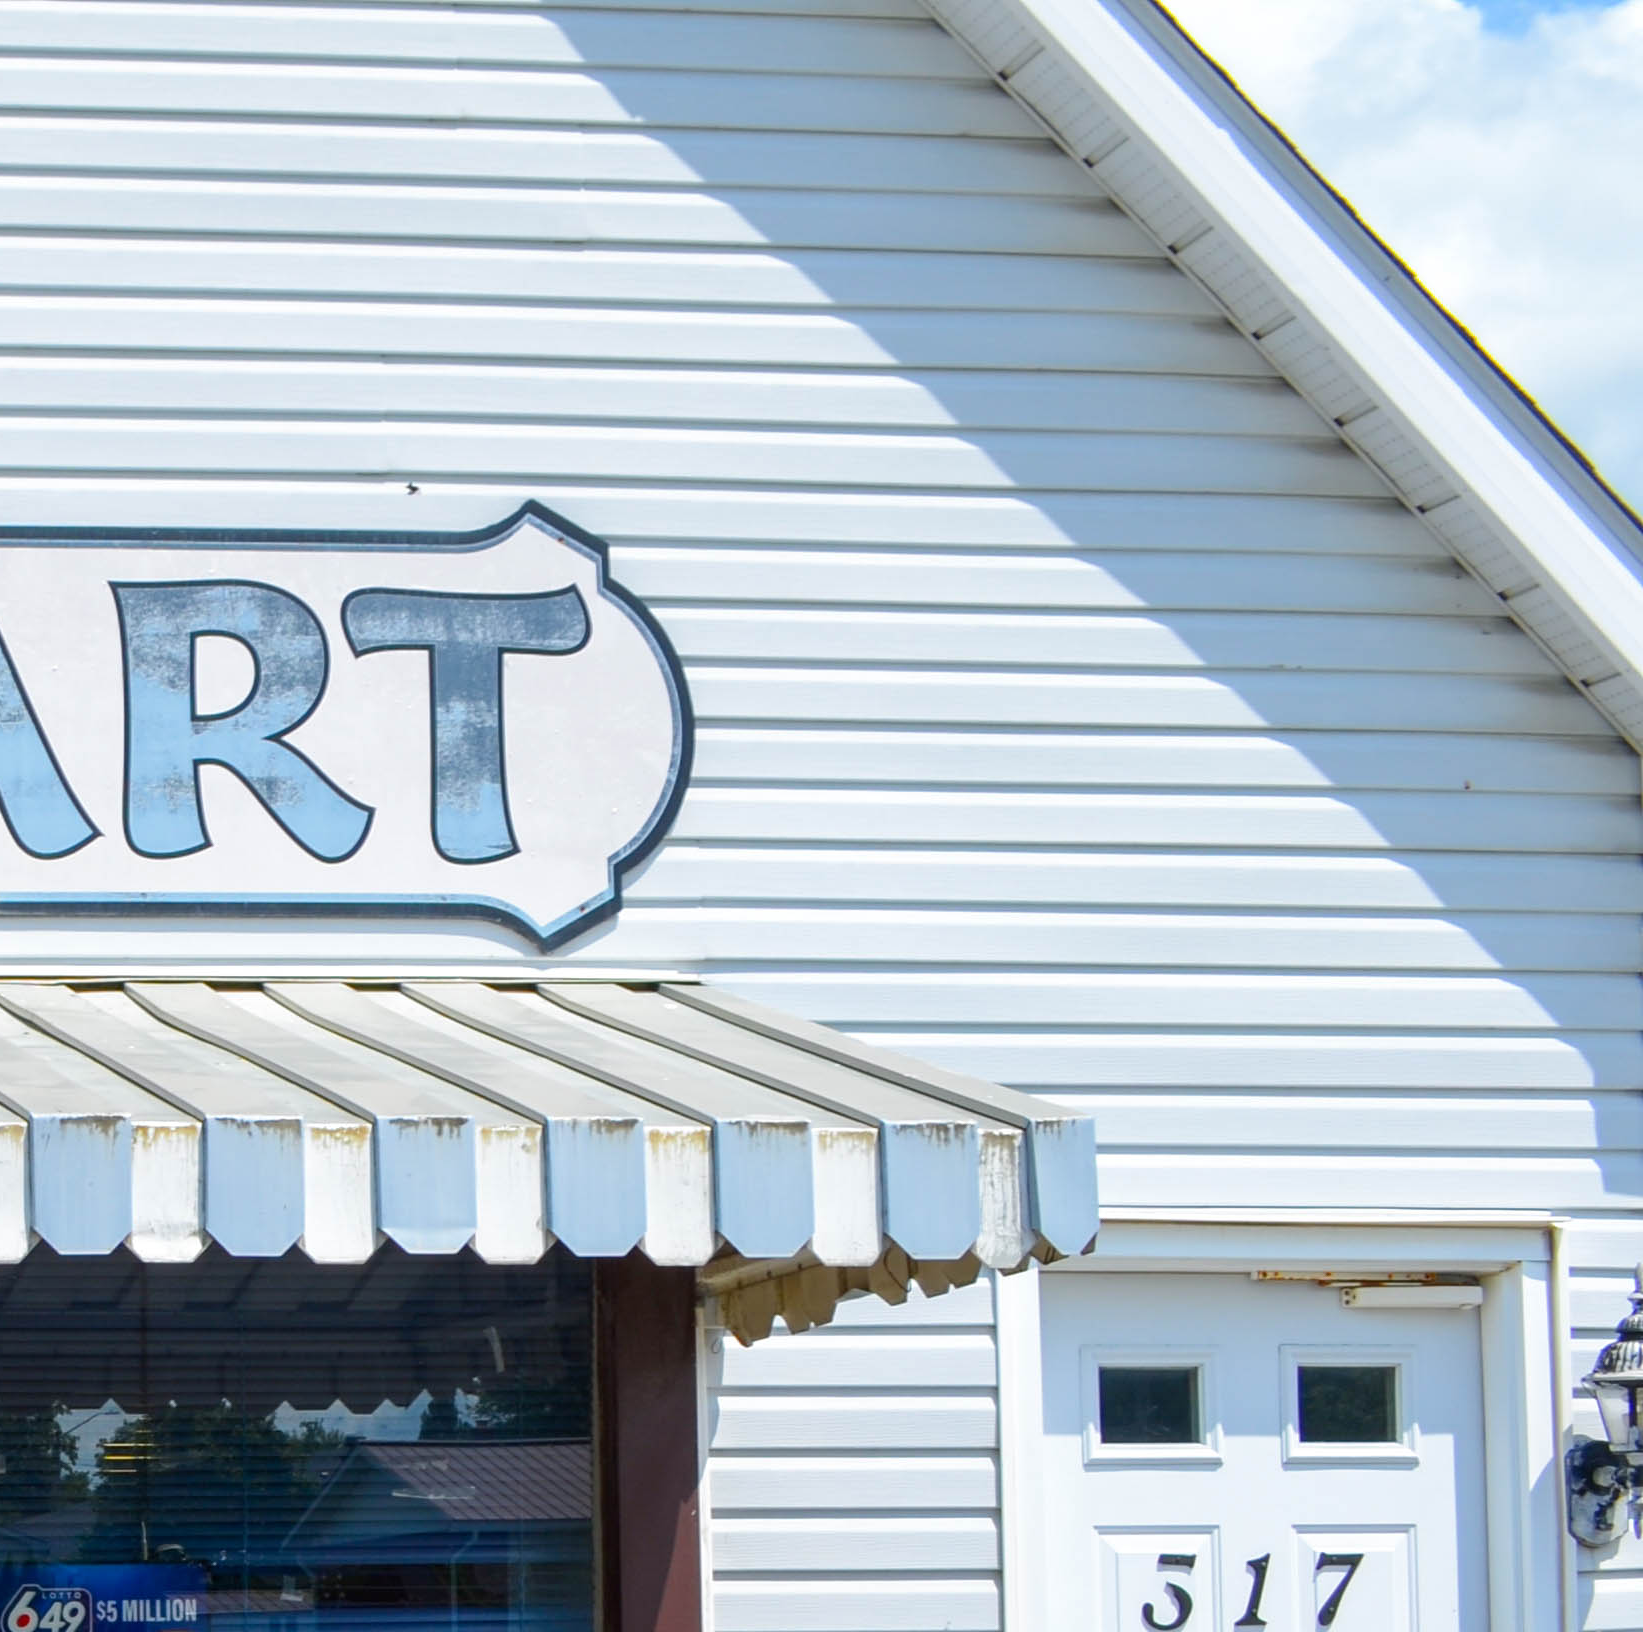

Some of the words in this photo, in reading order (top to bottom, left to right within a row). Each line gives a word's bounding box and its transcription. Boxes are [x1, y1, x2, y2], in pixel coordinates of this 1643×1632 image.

[42, 1591, 82, 1600] LOTTO
[1141, 1552, 1365, 1631] 517
[96, 1600, 117, 1622] $5
[122, 1598, 197, 1622] MILLION
